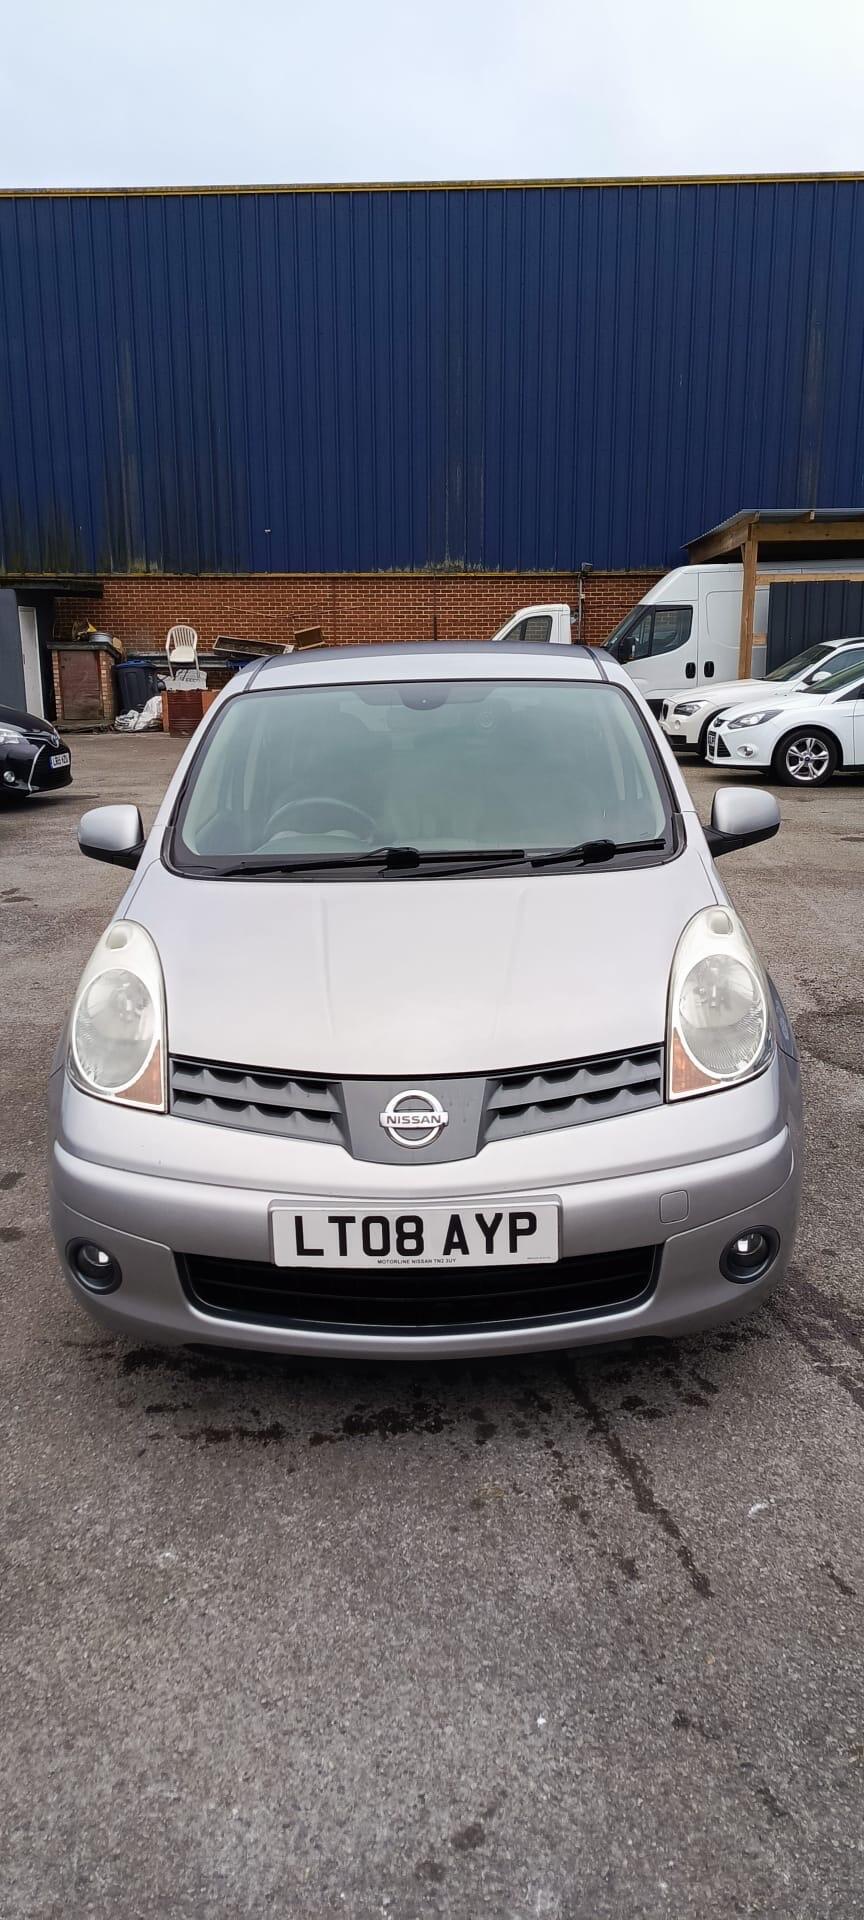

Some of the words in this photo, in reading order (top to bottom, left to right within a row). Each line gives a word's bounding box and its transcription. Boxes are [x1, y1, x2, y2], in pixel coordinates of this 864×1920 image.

[386, 1115, 441, 1124] NISSAN
[294, 1215, 424, 1256] LT08
[442, 1211, 537, 1255] AYP
